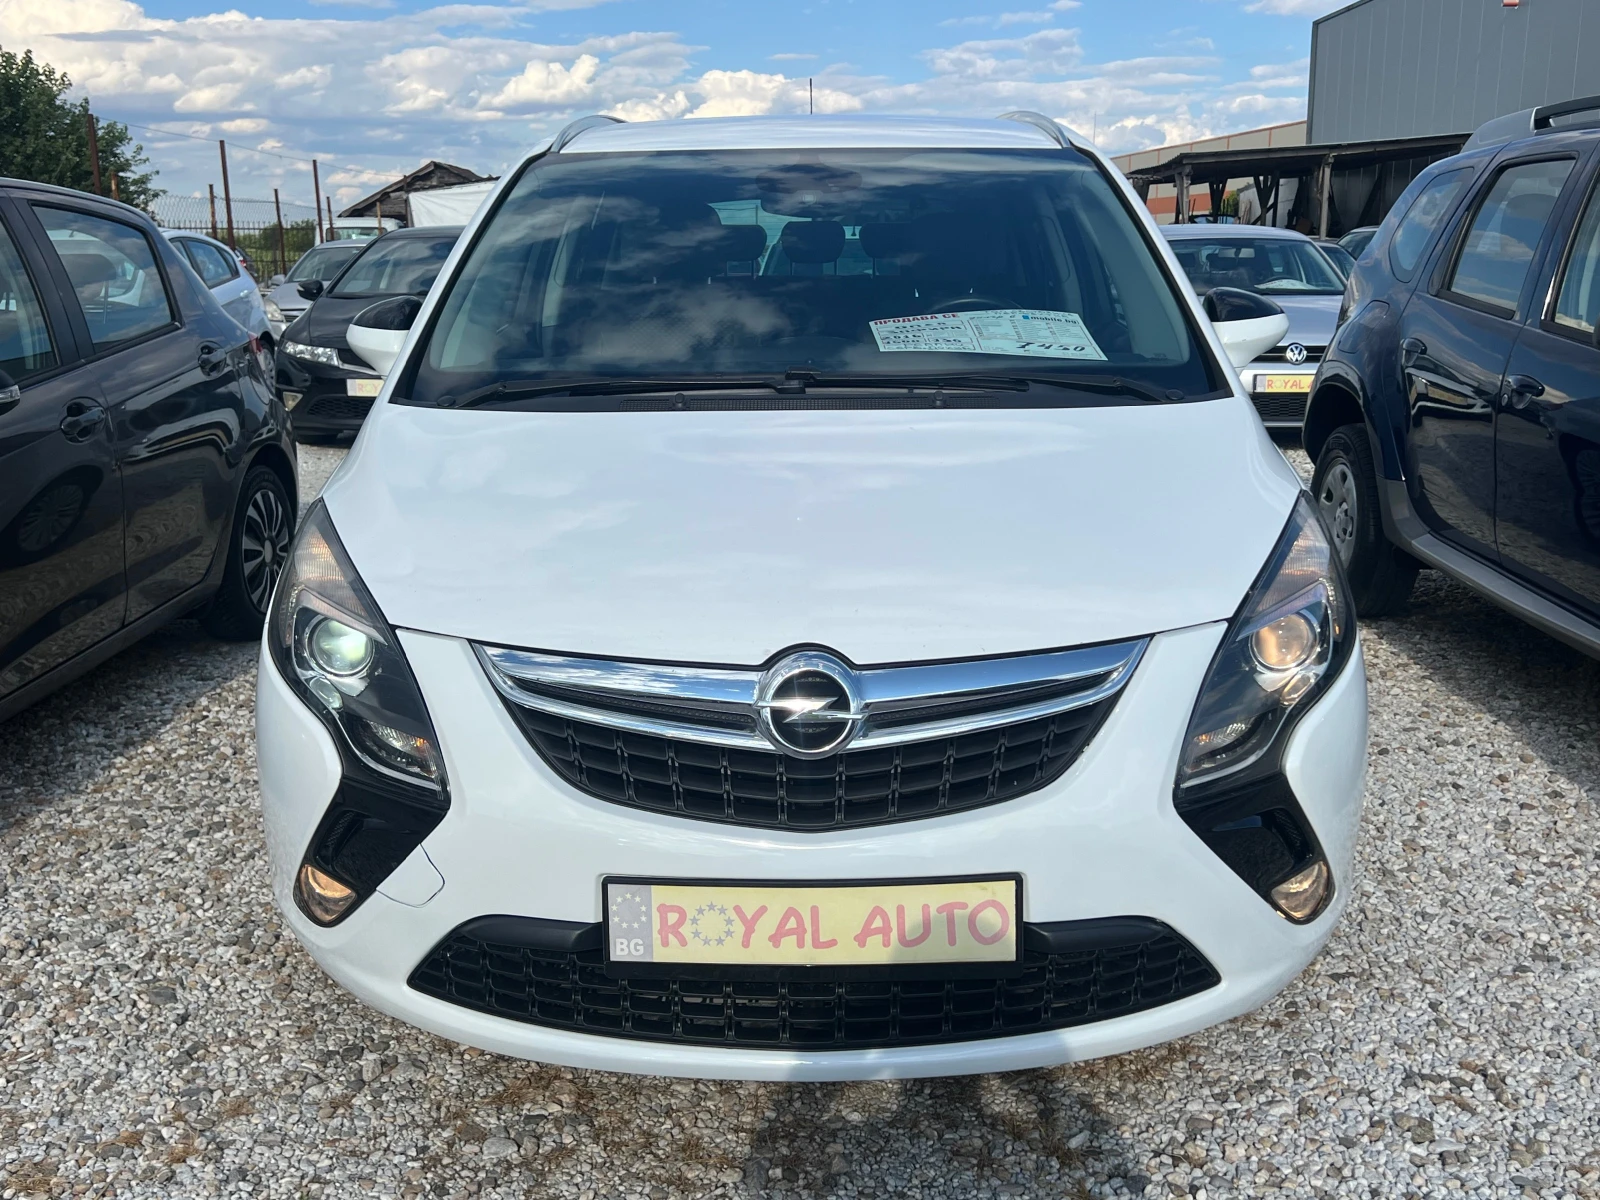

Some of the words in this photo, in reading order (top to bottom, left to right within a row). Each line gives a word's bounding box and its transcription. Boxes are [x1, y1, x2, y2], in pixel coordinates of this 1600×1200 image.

[874, 314, 939, 326] ПРОДАВА
[1266, 379, 1304, 390] ROYAL
[656, 901, 839, 949] ROYAL
[853, 899, 1011, 948] AUTO
[615, 938, 644, 956] BG
